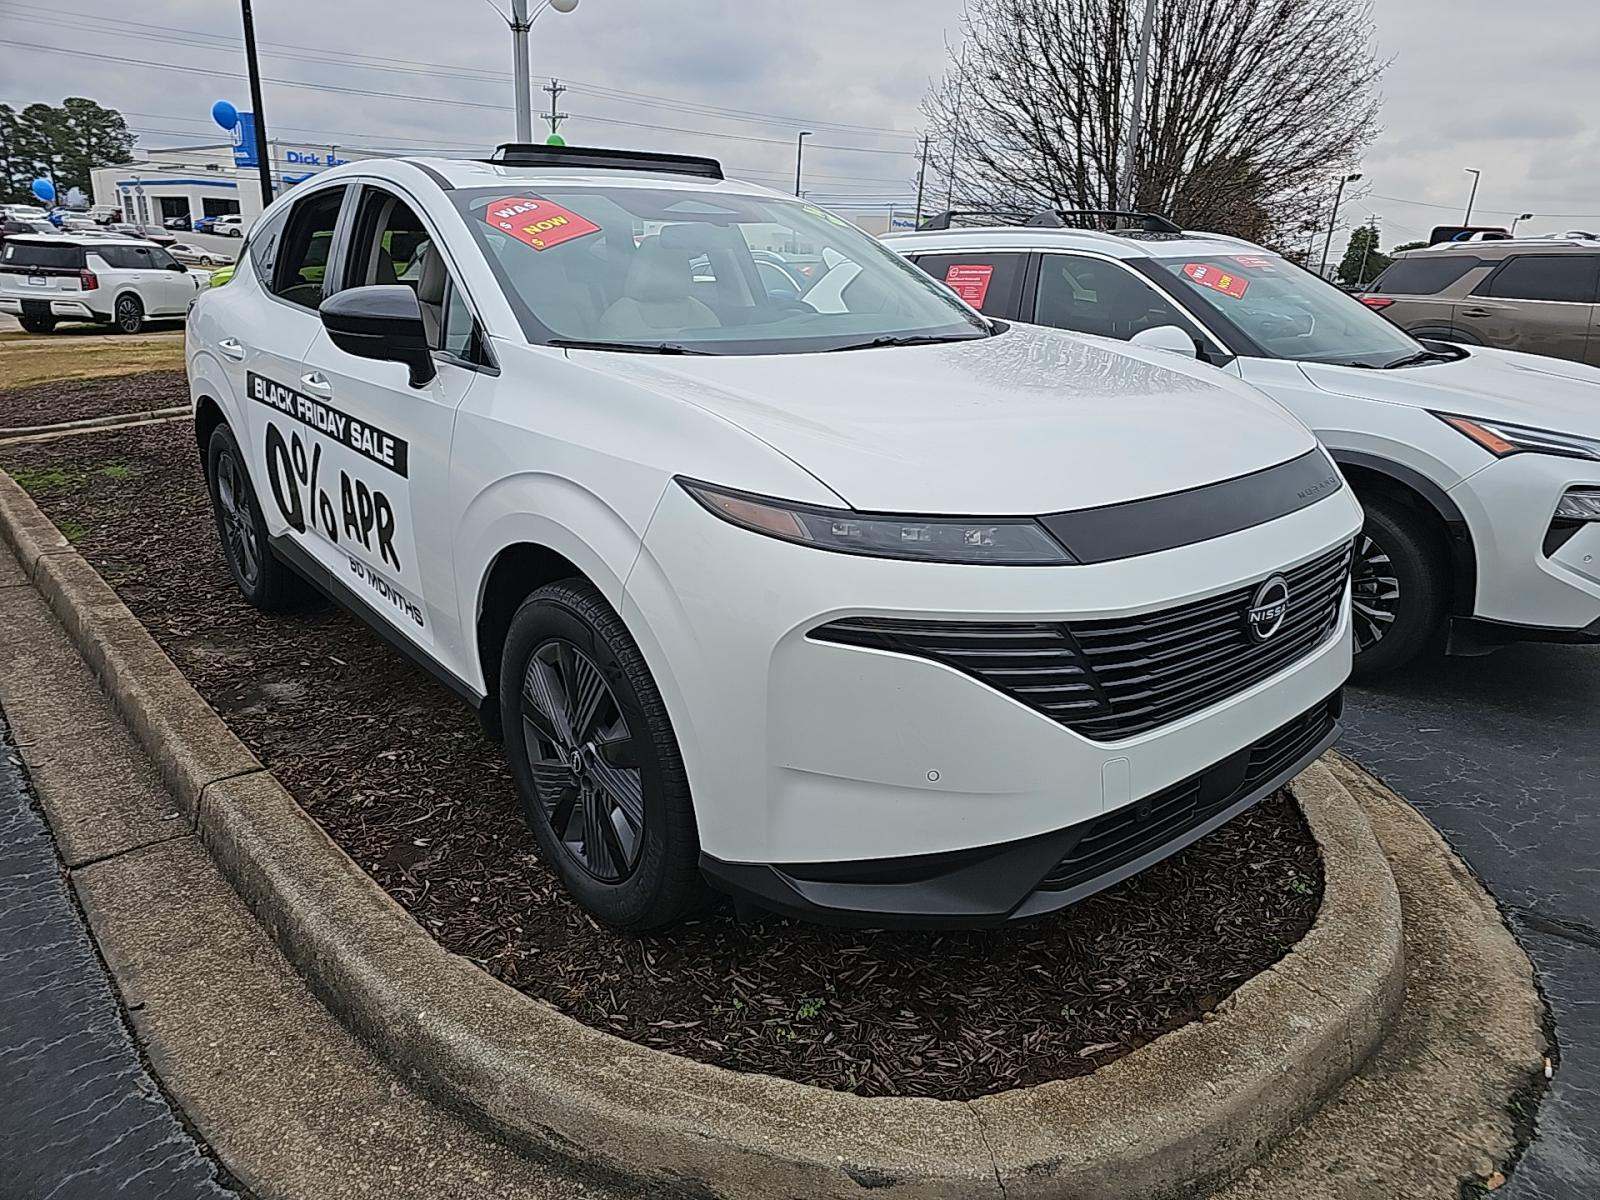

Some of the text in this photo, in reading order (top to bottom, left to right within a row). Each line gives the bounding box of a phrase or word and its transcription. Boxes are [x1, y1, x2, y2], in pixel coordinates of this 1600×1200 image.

[286, 151, 321, 166] Dick
[494, 202, 539, 218] WAS
[523, 216, 568, 235] NOW
[254, 377, 395, 467] BLACK FRIDAY SALE
[266, 422, 401, 573] 0% APR
[367, 569, 424, 627] MONTHS
